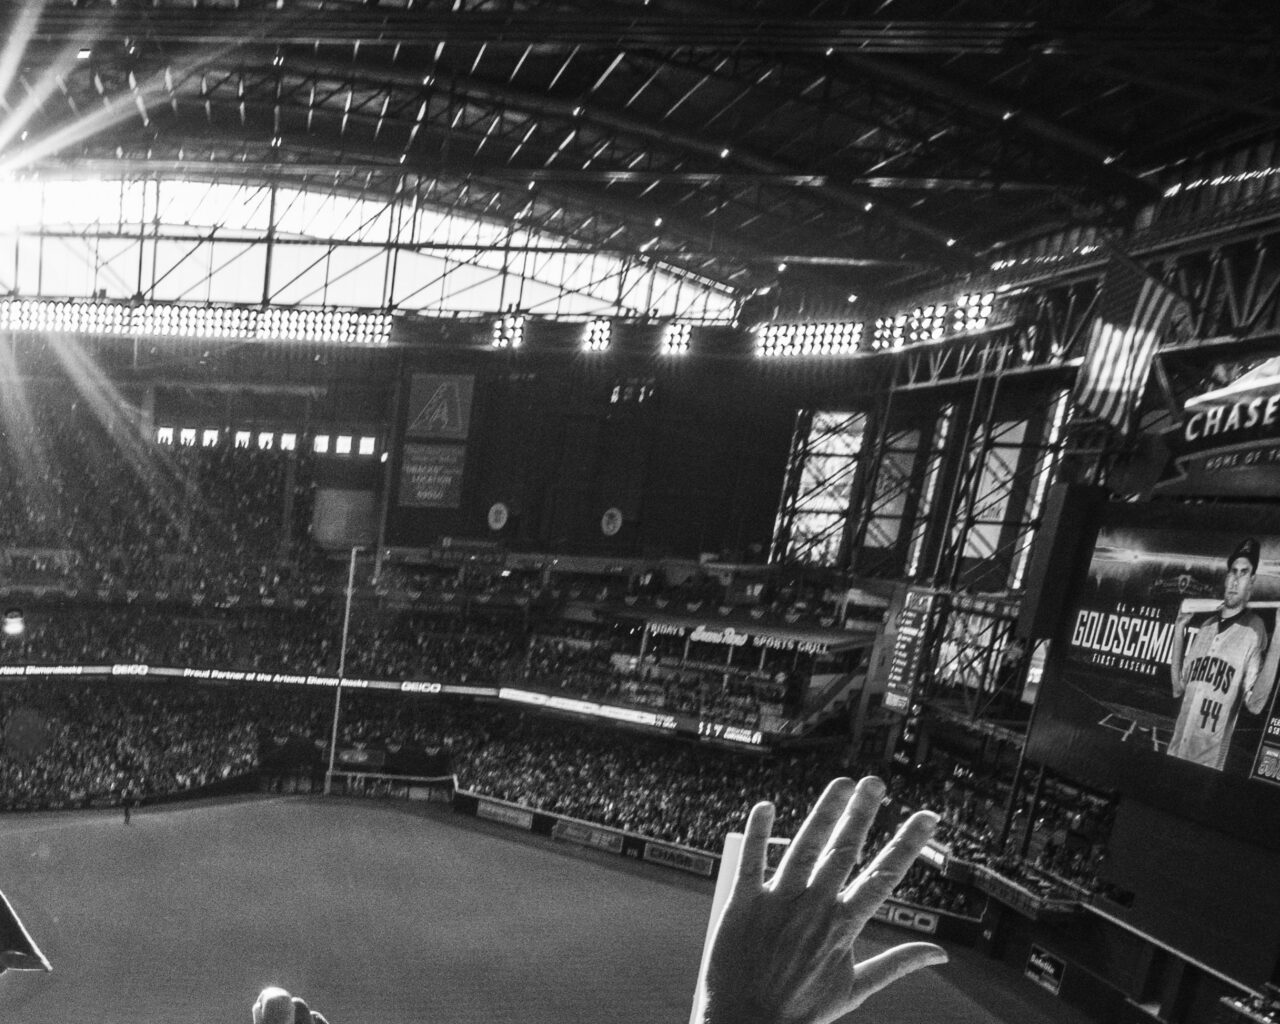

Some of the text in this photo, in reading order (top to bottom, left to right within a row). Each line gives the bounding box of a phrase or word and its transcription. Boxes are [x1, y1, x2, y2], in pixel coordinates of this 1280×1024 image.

[1185, 393, 1280, 441] CHASE
[1139, 605, 1161, 618] PAUL
[753, 635, 794, 651] SPORTS
[797, 641, 829, 655] GRILL
[1071, 610, 1200, 664] GOLDSCHMIT
[113, 664, 148, 675] GEICO
[1092, 653, 1157, 675] FIRST BASEMAN
[401, 681, 442, 694] GEICO
[1200, 698, 1223, 733] 44
[873, 903, 934, 932] EICO
